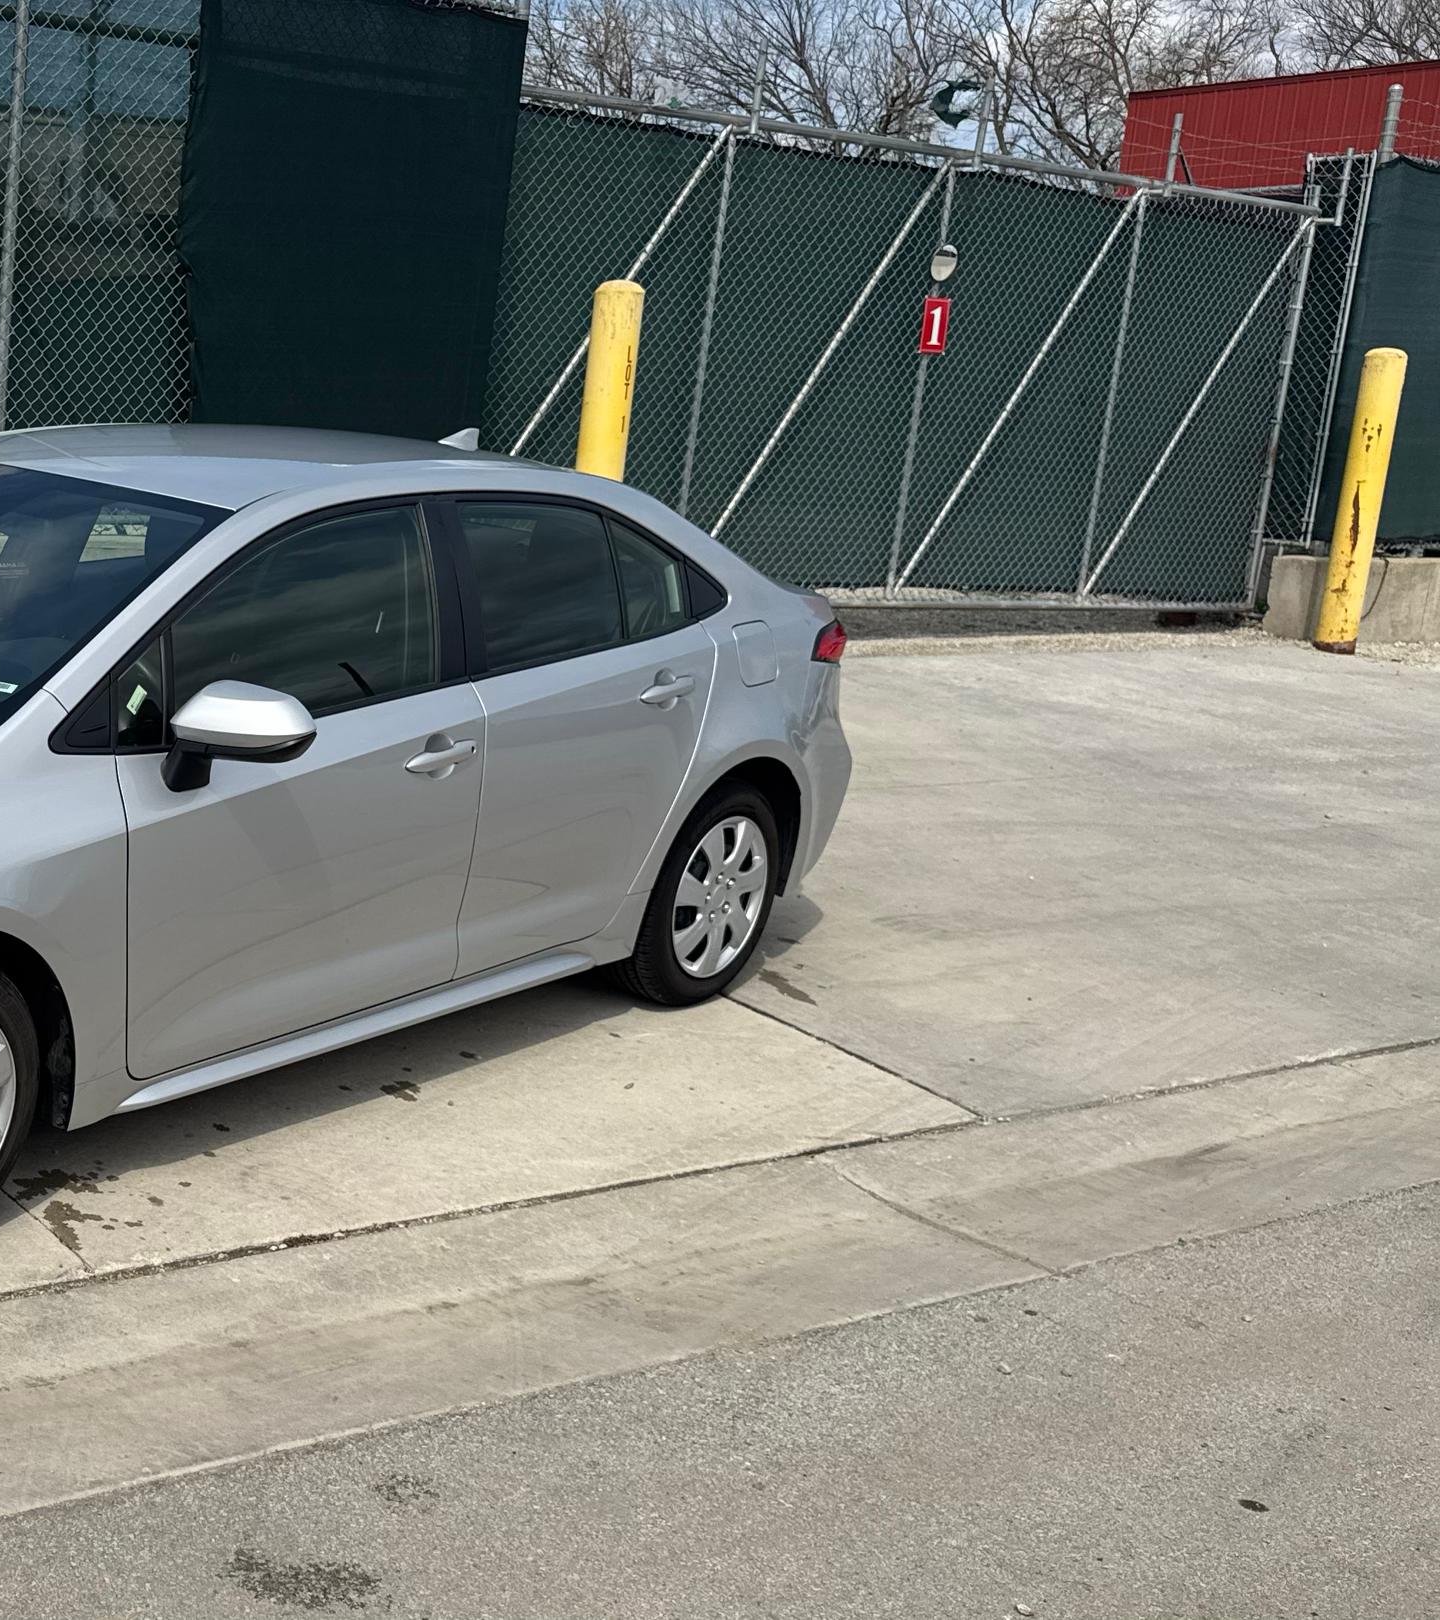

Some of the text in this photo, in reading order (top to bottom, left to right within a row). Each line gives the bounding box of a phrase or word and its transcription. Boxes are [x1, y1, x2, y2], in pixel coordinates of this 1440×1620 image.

[926, 306, 942, 346] 1
[621, 345, 632, 433] LOT 1
